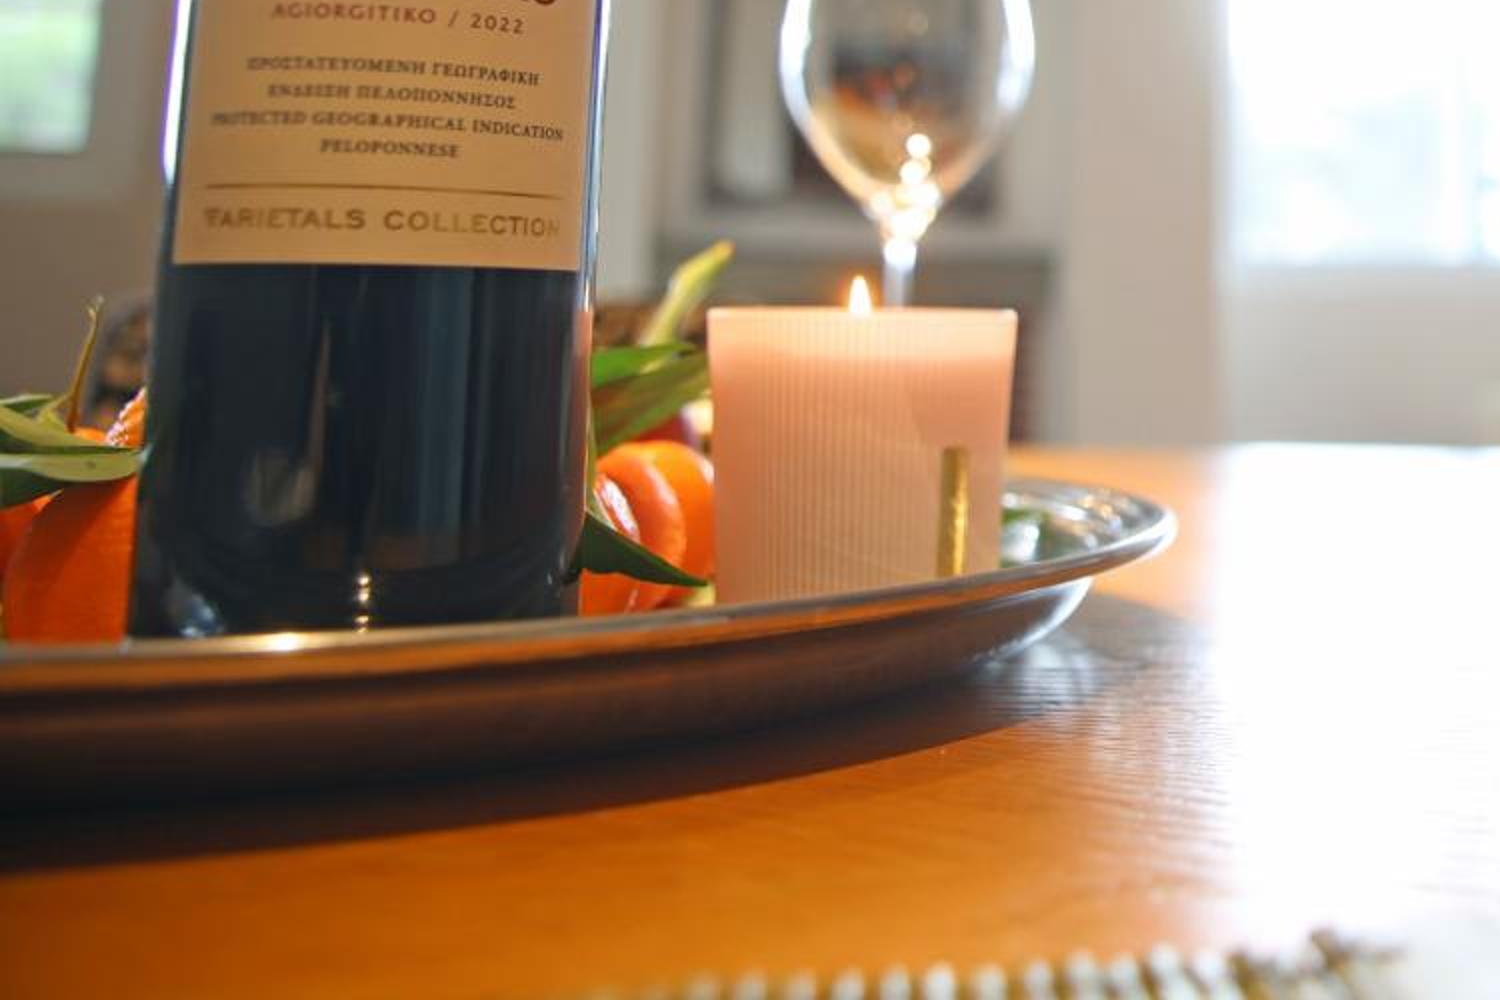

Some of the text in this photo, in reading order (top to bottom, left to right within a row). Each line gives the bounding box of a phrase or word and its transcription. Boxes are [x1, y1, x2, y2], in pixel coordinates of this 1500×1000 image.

[271, 2, 436, 24] AGIORGITIKO
[470, 12, 525, 34] 2022
[432, 61, 540, 86] ΓΕΩΓΡΑΦΙΚΗ
[356, 85, 516, 109] ΠΕΛΟΠΟΝΝΗΣΟΣ
[311, 111, 466, 132] GEOGRAPHICAL
[472, 118, 564, 141] INDICATION
[320, 138, 461, 158] PELOPONNESE
[383, 209, 560, 237] COLLECTION
